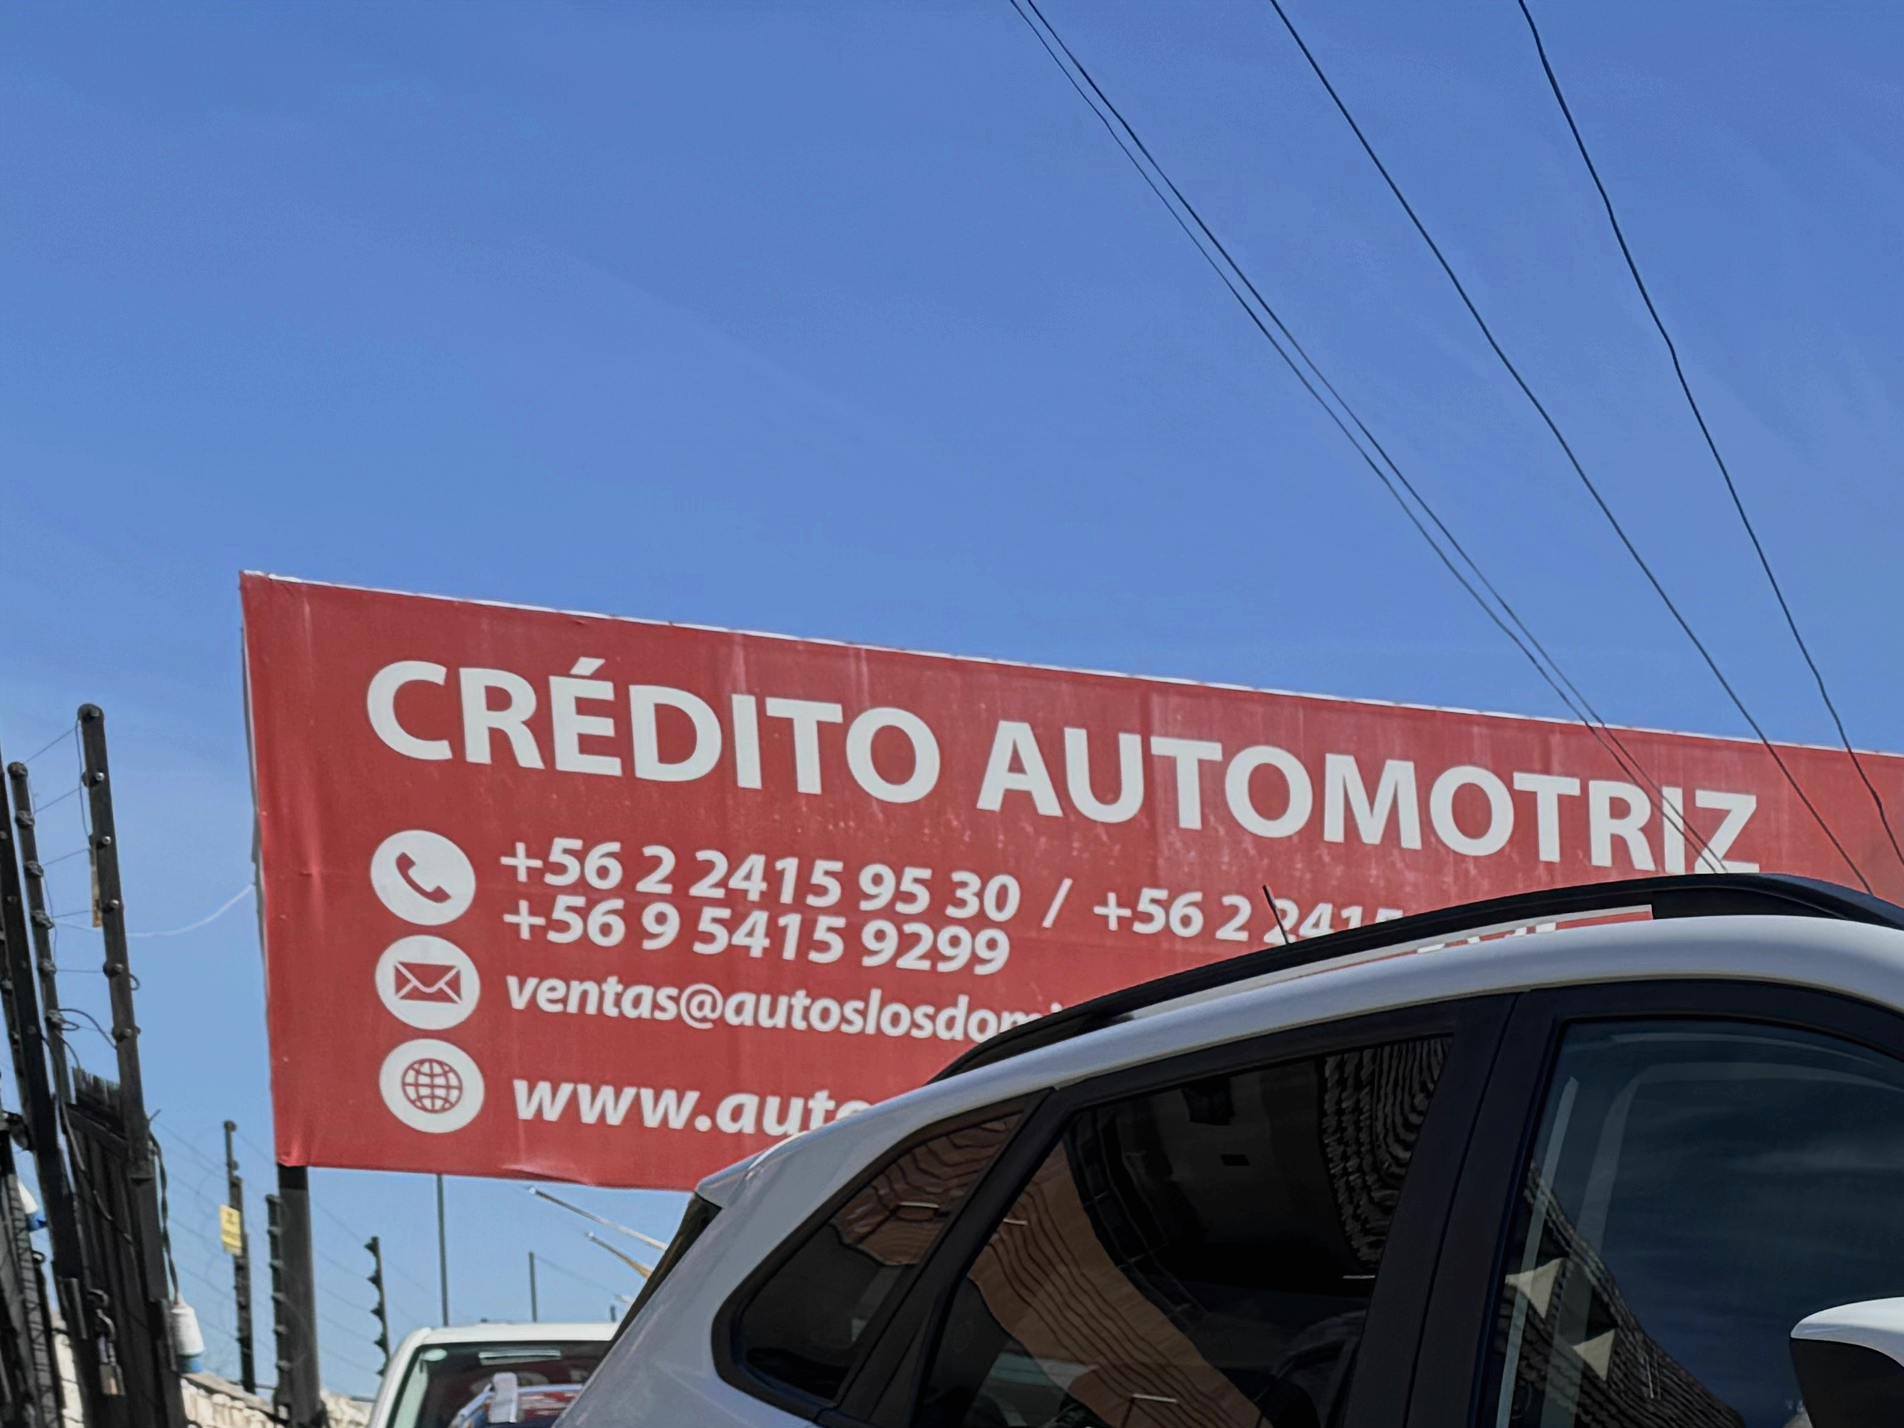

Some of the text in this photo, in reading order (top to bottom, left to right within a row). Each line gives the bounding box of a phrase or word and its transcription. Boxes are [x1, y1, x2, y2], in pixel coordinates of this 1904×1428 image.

[366, 657, 1758, 874] CRÉDITO AUTOMOTRIZ
[500, 837, 623, 890] +56
[635, 845, 676, 894] 2
[689, 850, 844, 909] 2415
[859, 864, 932, 915] 95
[945, 871, 1020, 921] 30
[1094, 887, 1204, 937] +56
[1214, 895, 1252, 941] 2
[503, 895, 1010, 976] +56 9 5415 9299
[506, 975, 1063, 1043] ventas@autoslosdo
